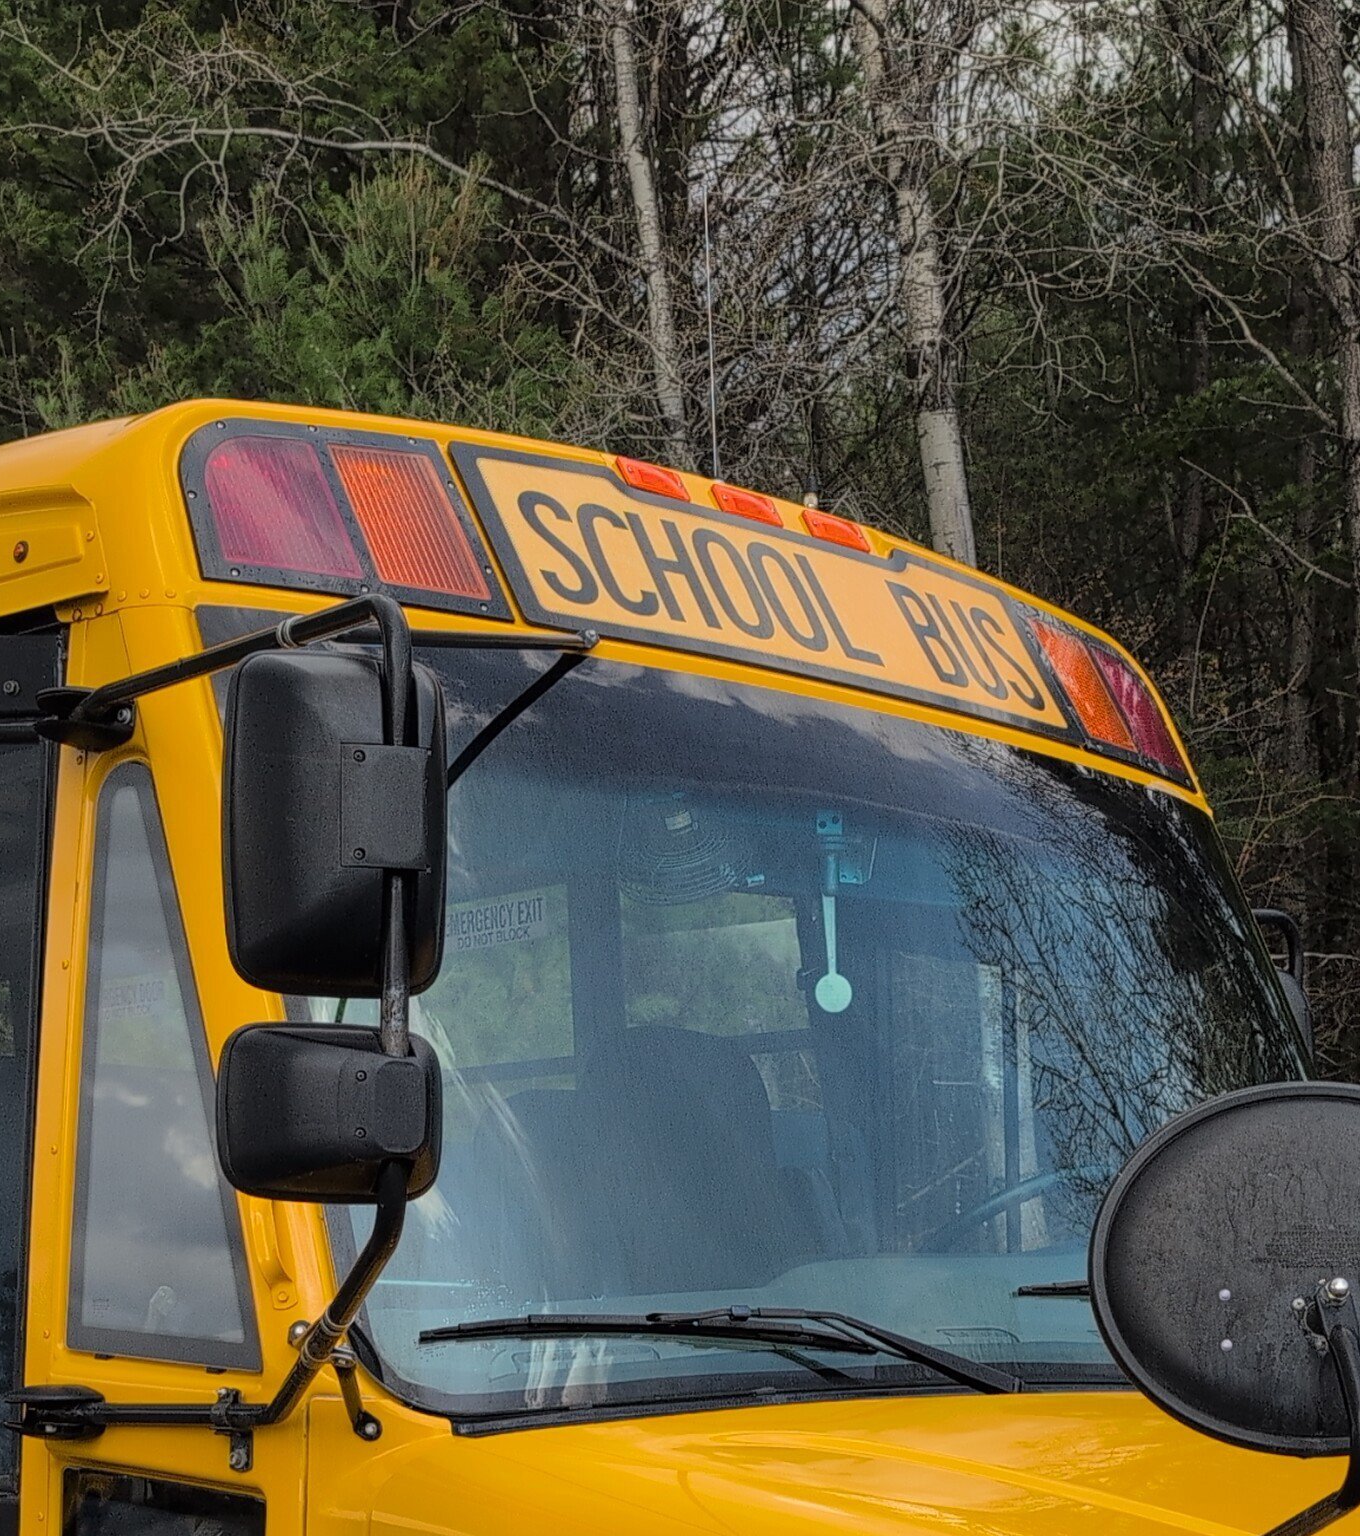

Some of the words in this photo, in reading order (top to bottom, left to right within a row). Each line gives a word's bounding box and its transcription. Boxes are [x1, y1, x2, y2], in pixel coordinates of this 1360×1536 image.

[516, 489, 883, 668] SCHOOL
[886, 580, 1045, 711] BUS
[517, 897, 543, 925] EXIT
[496, 926, 530, 943] BLOCK
